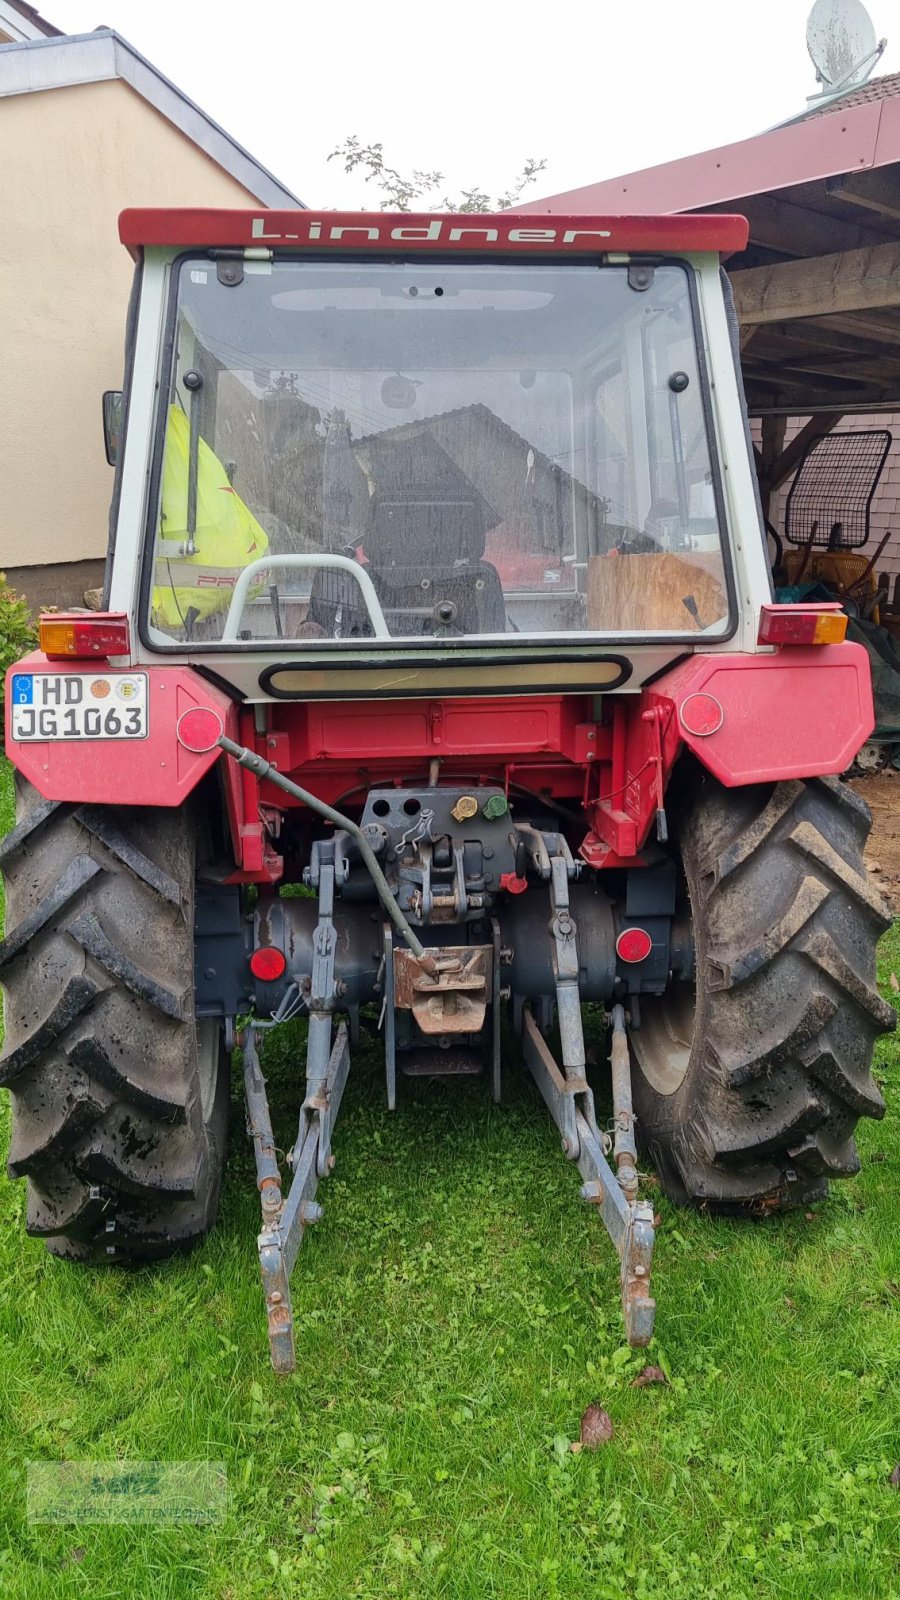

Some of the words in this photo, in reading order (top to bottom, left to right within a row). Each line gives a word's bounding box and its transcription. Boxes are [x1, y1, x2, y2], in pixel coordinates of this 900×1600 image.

[252, 218, 611, 243] Lindner
[19, 693, 28, 703] D
[42, 677, 83, 705] HD
